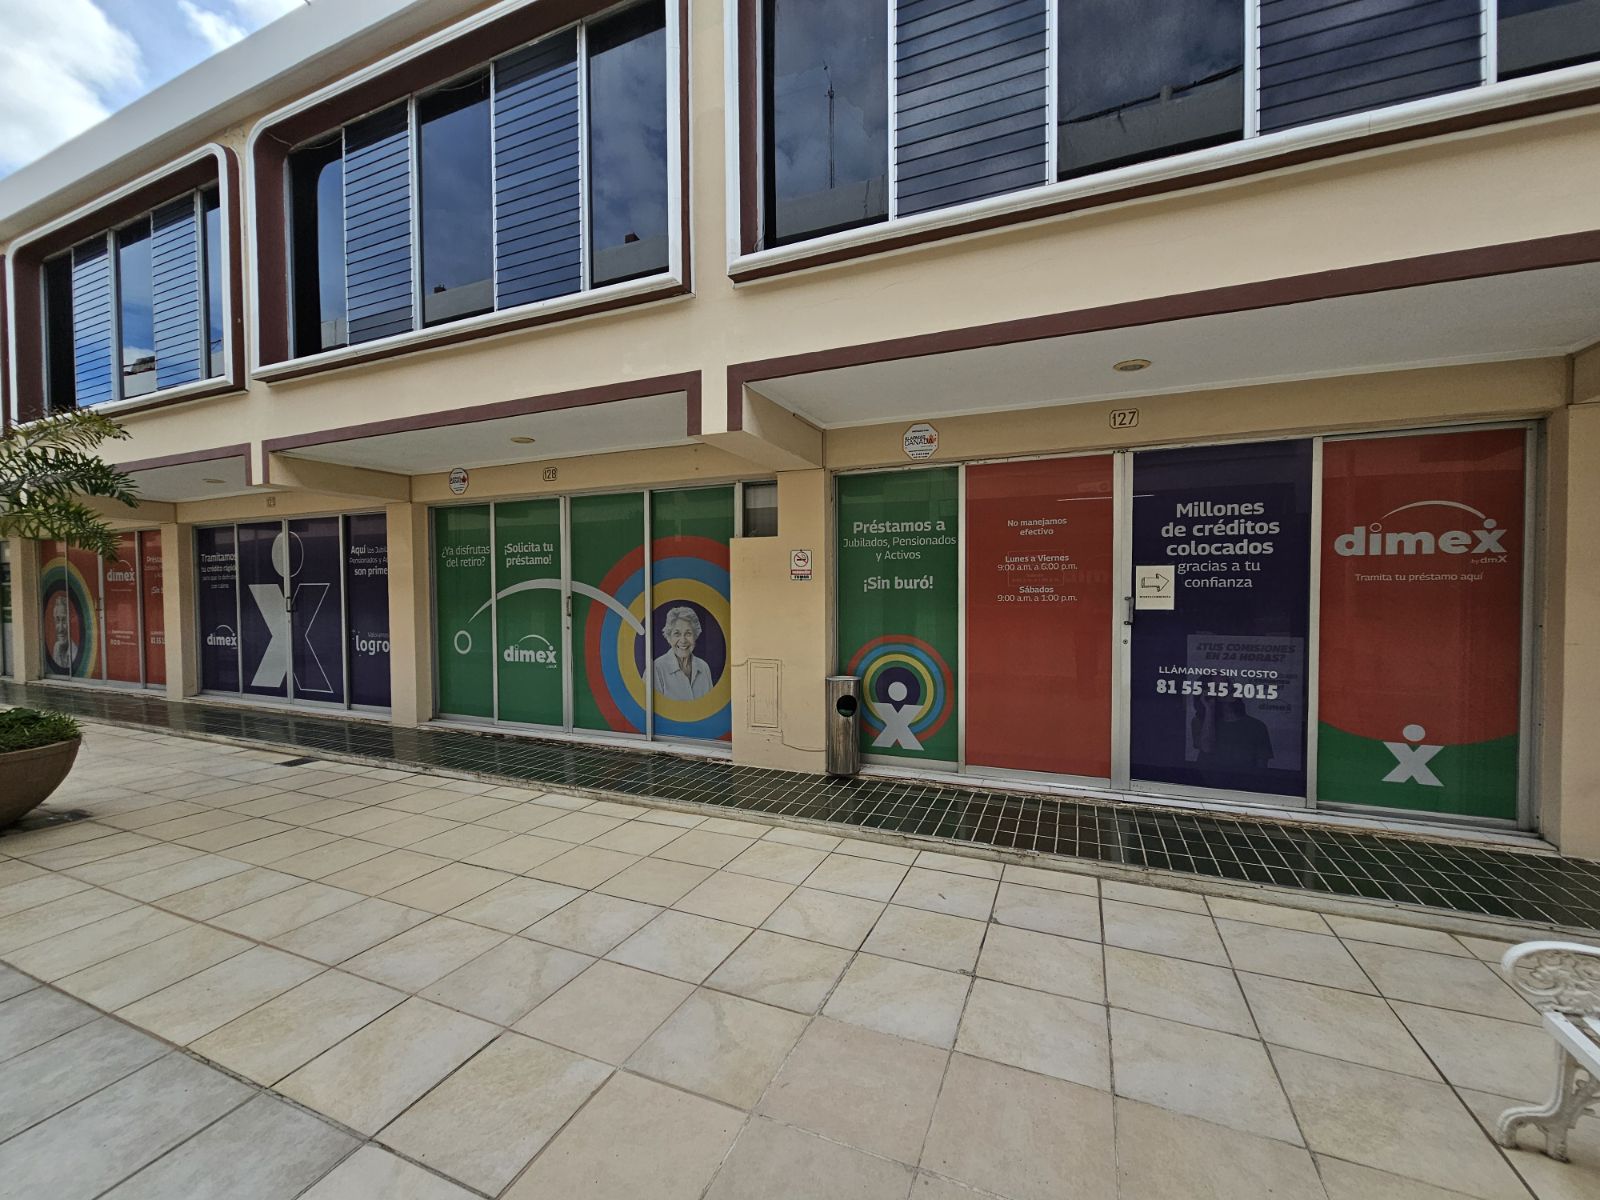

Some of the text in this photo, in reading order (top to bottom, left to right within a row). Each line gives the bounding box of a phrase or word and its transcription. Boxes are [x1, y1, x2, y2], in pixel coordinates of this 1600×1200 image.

[1112, 411, 1136, 427] 127
[1176, 501, 1265, 518] Millones
[853, 520, 946, 534] Préstamos a
[1007, 518, 1067, 527] No manejamos
[1161, 518, 1280, 538] de créditos
[1020, 528, 1054, 536] efectivo
[1334, 518, 1507, 557] dimex
[843, 535, 957, 548] Jubilados, Pensionados
[1166, 539, 1274, 556] colocados
[351, 545, 366, 556] Aquí
[441, 545, 490, 558] ¿Ya disfrutas
[504, 542, 554, 555] ¡Solicita tu
[446, 556, 486, 567] del retiro?
[506, 554, 552, 568] préstamo!
[875, 550, 921, 562] y Activos
[1005, 554, 1029, 563] Lunes
[1038, 554, 1070, 562] Viernes
[997, 563, 1015, 571] 9:00
[1040, 562, 1059, 570] 6:00
[1060, 563, 1078, 572] p.m.
[1177, 560, 1261, 574] gracias a tu
[106, 568, 136, 582] dimex
[1355, 571, 1483, 582] Tramita tu préstamo aquí
[863, 575, 934, 592] ¡Sin buró!
[1019, 585, 1054, 593] Sábados
[1184, 577, 1253, 588] confianza
[997, 594, 1015, 602] 9:00
[1041, 594, 1059, 602] 1:00
[1060, 594, 1078, 602] p.m.
[206, 632, 237, 646] dimex
[503, 644, 557, 664] dimex
[1226, 643, 1296, 653] COMISIONES
[1222, 652, 1237, 660] 24
[1239, 653, 1287, 662] HORAS?
[1158, 664, 1278, 679] LLÁMANOS SIN COSTO
[1156, 679, 1278, 700] 81 55 15 2015
